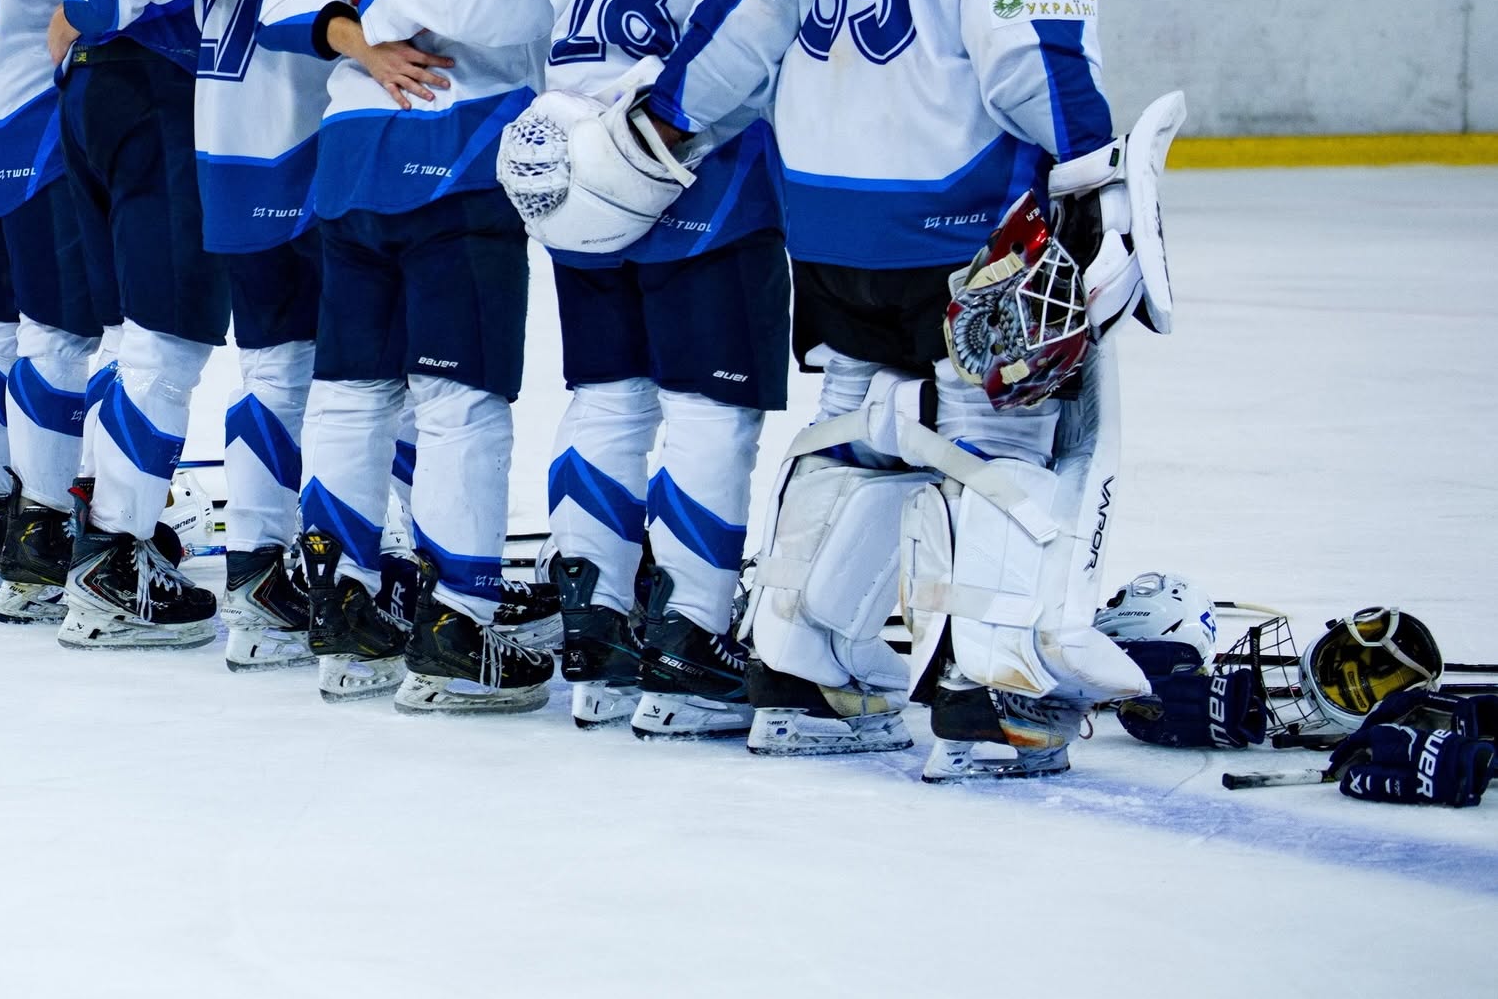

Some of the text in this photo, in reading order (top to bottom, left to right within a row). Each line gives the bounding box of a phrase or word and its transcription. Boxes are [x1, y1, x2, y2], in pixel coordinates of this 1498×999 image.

[1026, 1, 1096, 16] УКРАЇН
[5, 167, 37, 179] TWOL
[420, 165, 452, 178] TWOL
[266, 207, 305, 218] TWOL
[944, 212, 988, 226] TWOL
[675, 219, 712, 233] TWOL
[417, 356, 459, 369] BAUER
[1083, 475, 1115, 572] VAPOR
[658, 655, 706, 675] BAUER
[1209, 676, 1231, 747] BAU
